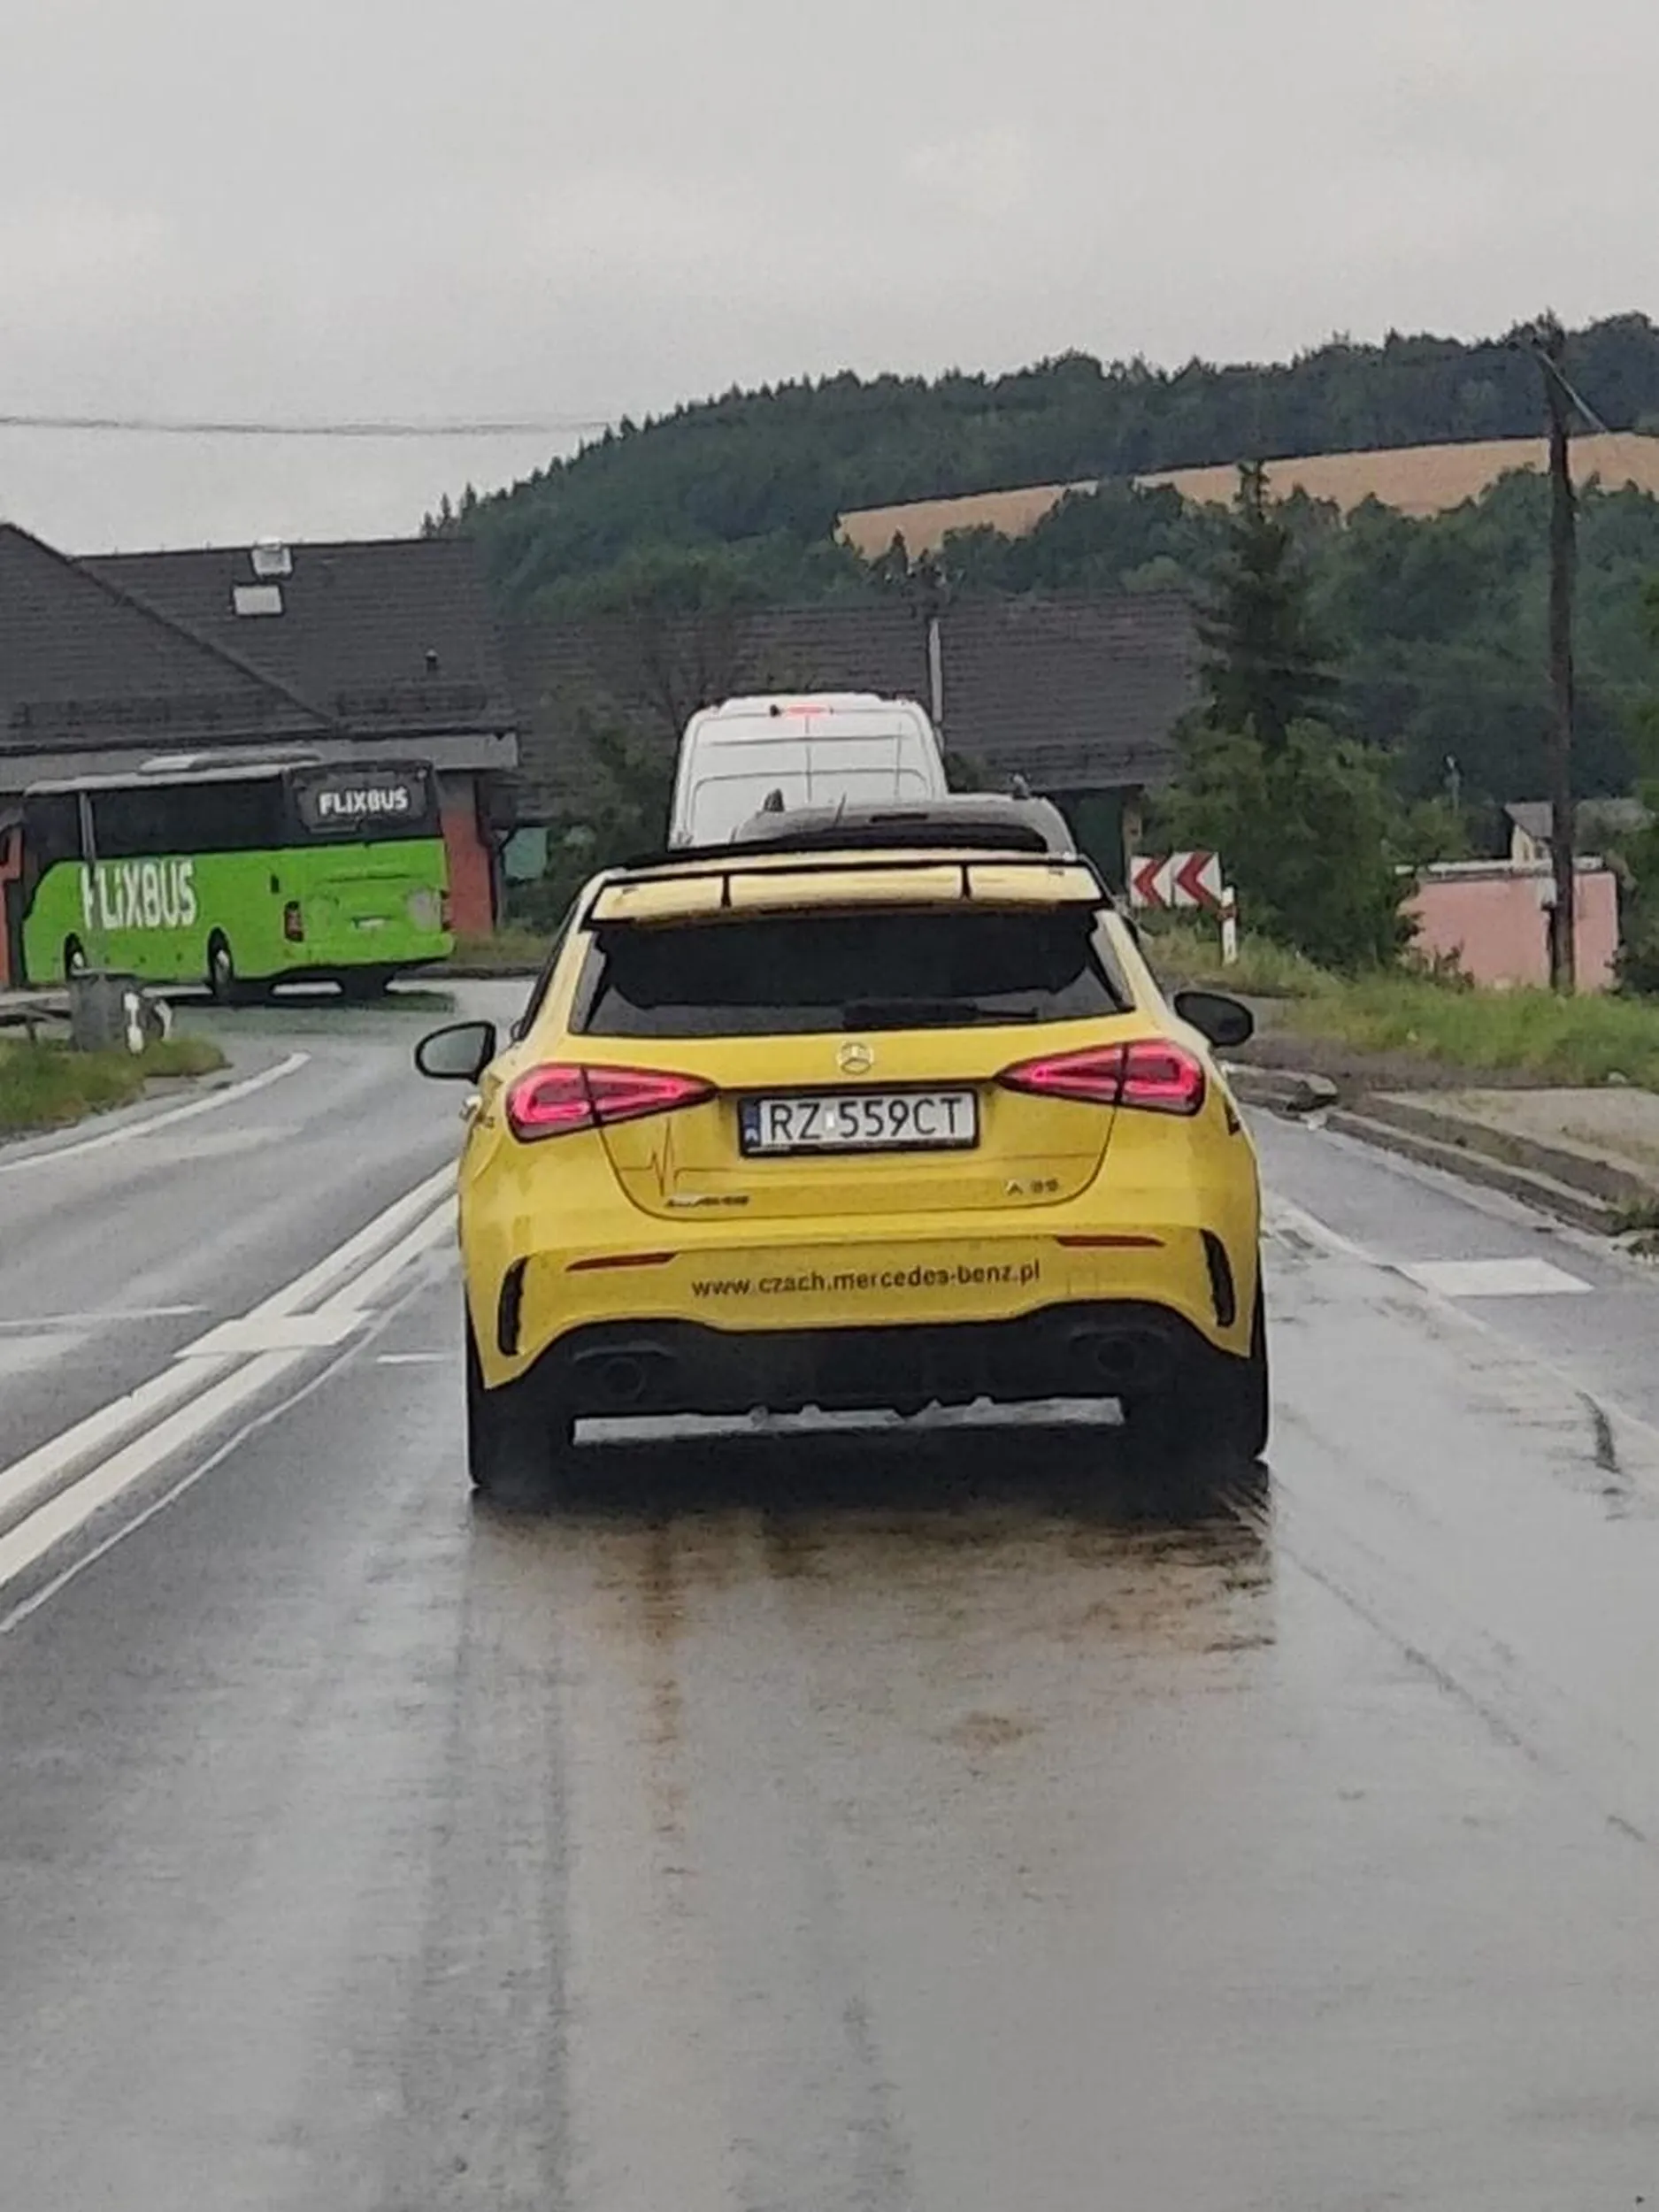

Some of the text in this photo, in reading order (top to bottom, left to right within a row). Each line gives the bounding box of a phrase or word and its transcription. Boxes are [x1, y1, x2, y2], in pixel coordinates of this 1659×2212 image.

[770, 1096, 963, 1141] RZ 559CT
[691, 1259, 1041, 1296] www.czach.mercedes-benz.pl
